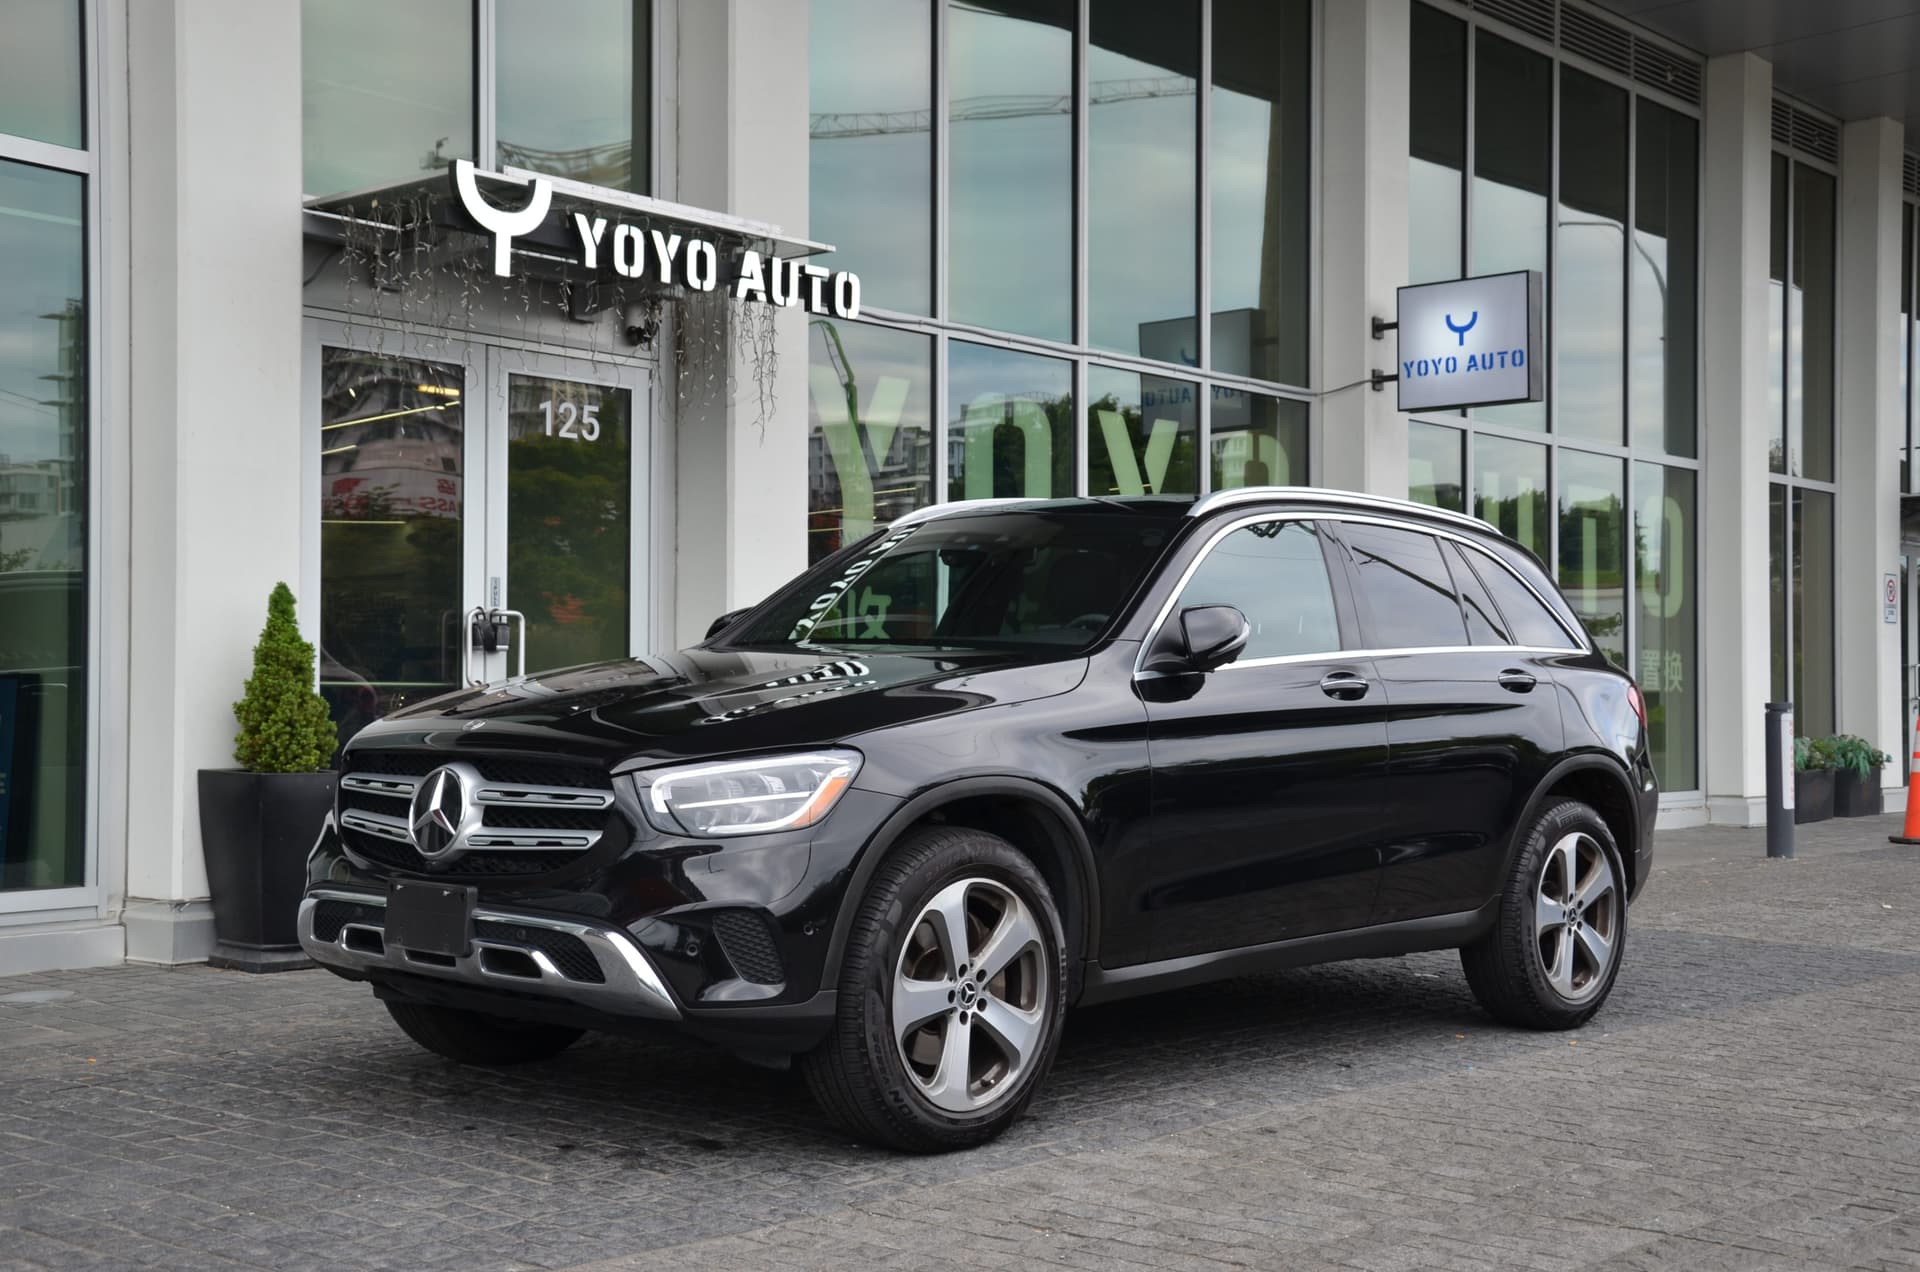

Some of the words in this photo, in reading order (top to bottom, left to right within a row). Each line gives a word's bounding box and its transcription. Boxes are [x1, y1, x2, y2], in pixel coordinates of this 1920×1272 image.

[574, 212, 717, 292] YOYO
[736, 250, 862, 320] AUTO
[1403, 356, 1457, 379] YOYO
[1466, 348, 1525, 373] AUTO
[539, 400, 600, 441] 125
